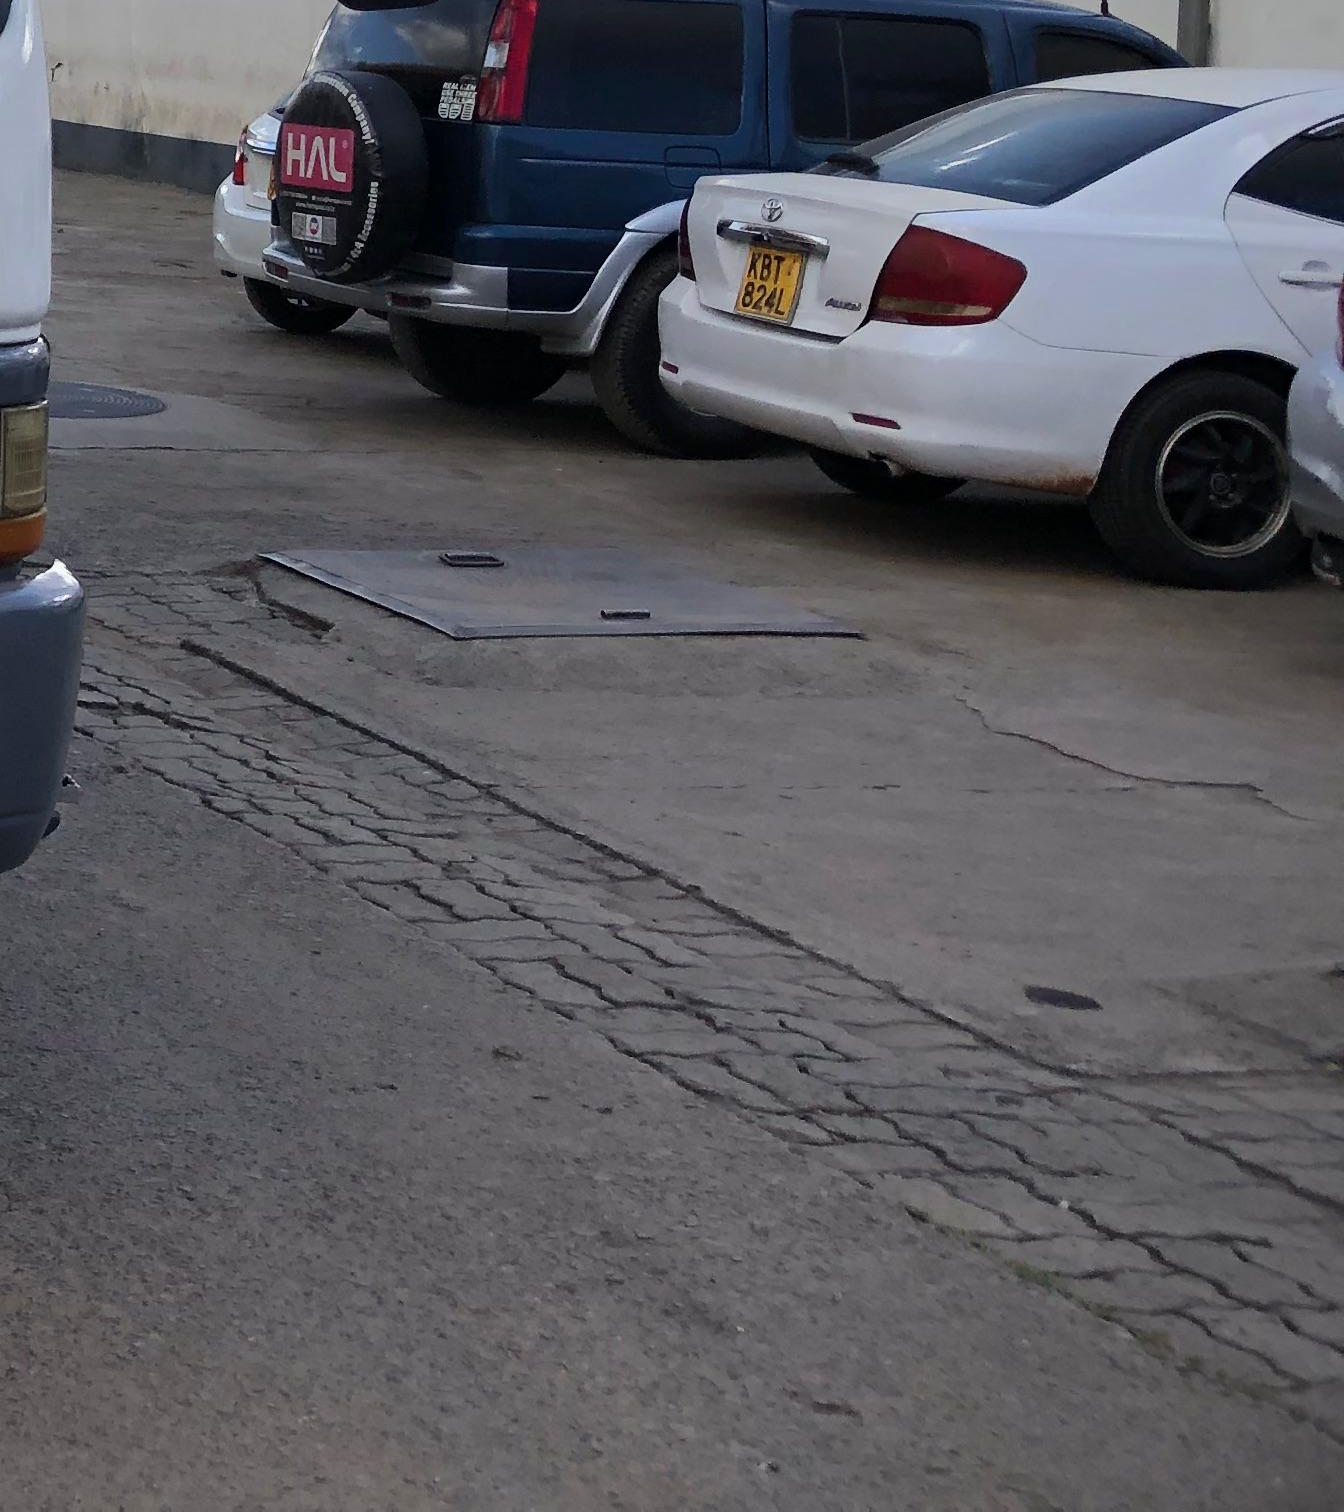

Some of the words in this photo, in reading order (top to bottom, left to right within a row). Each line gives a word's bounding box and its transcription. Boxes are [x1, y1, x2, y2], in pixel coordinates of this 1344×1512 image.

[286, 132, 347, 184] HAL
[746, 251, 786, 285] KBT
[741, 281, 786, 316] 824L
